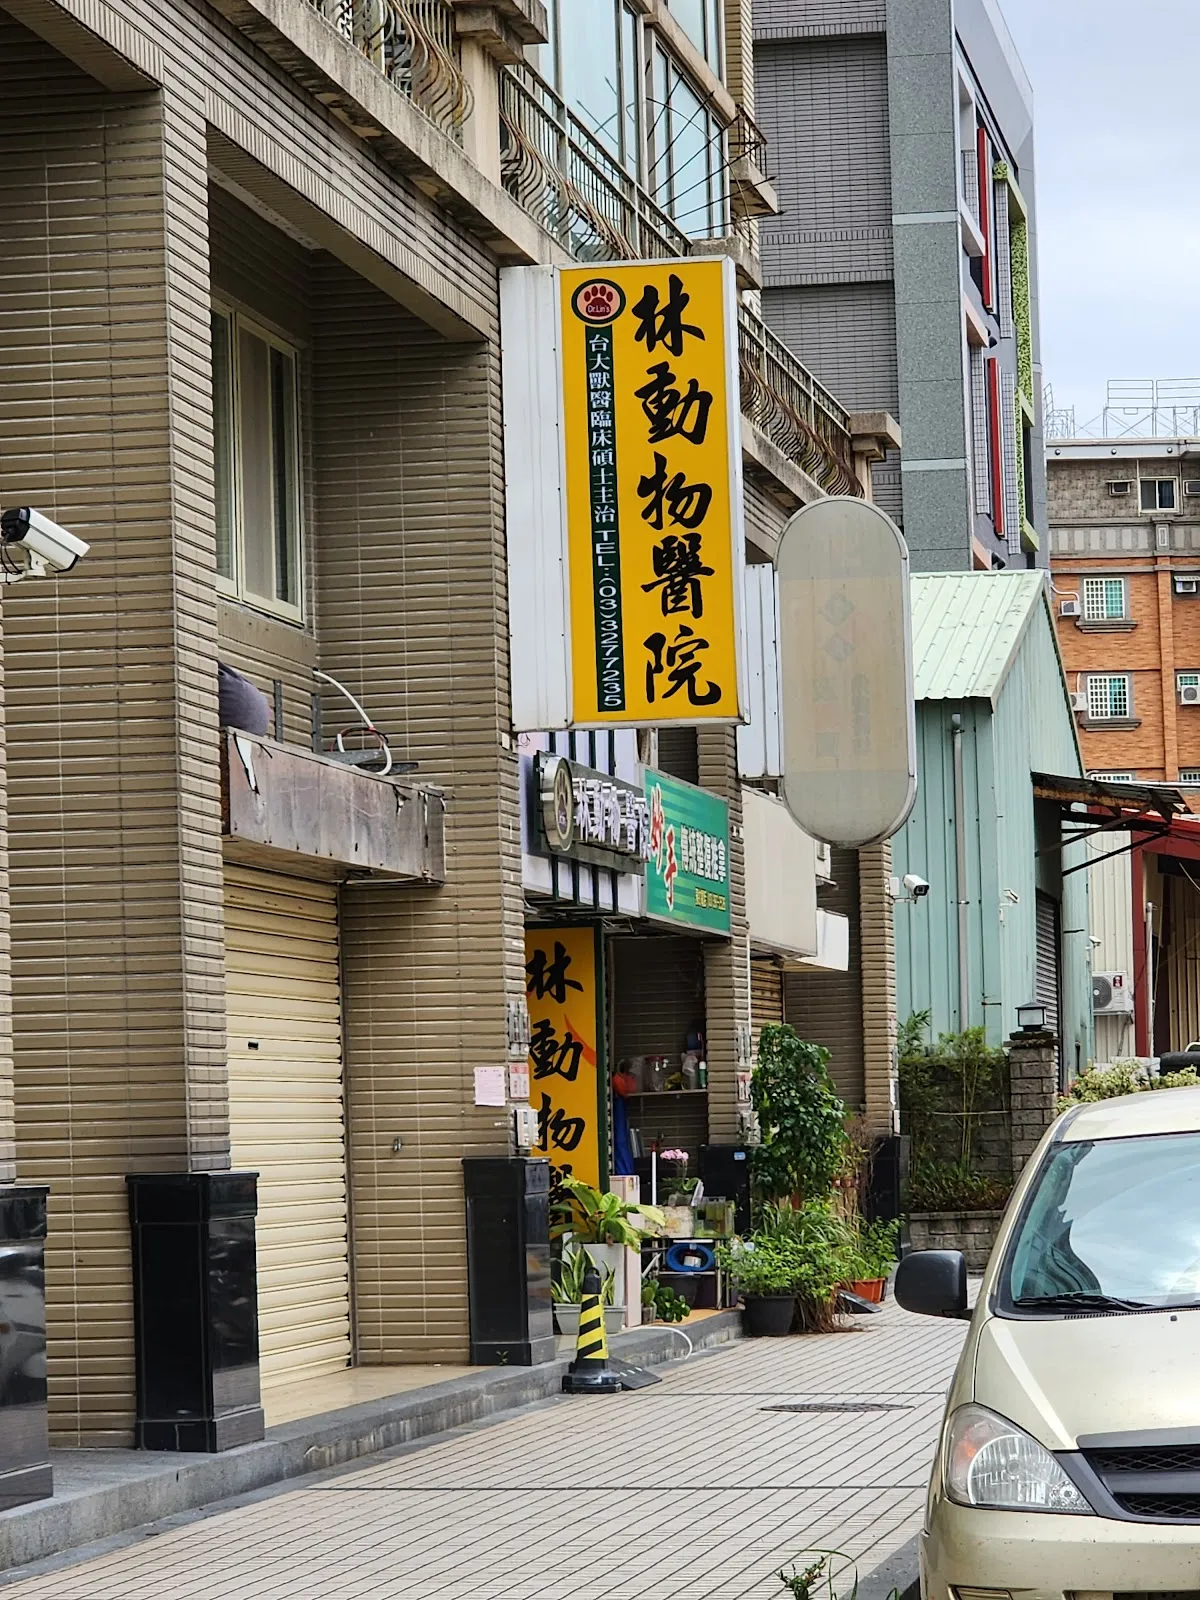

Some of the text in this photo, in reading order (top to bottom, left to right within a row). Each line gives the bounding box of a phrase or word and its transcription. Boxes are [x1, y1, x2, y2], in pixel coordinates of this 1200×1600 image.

[588, 334, 616, 524] 台大獸醫臨床碩士主治
[631, 273, 722, 707] 林動物醫院
